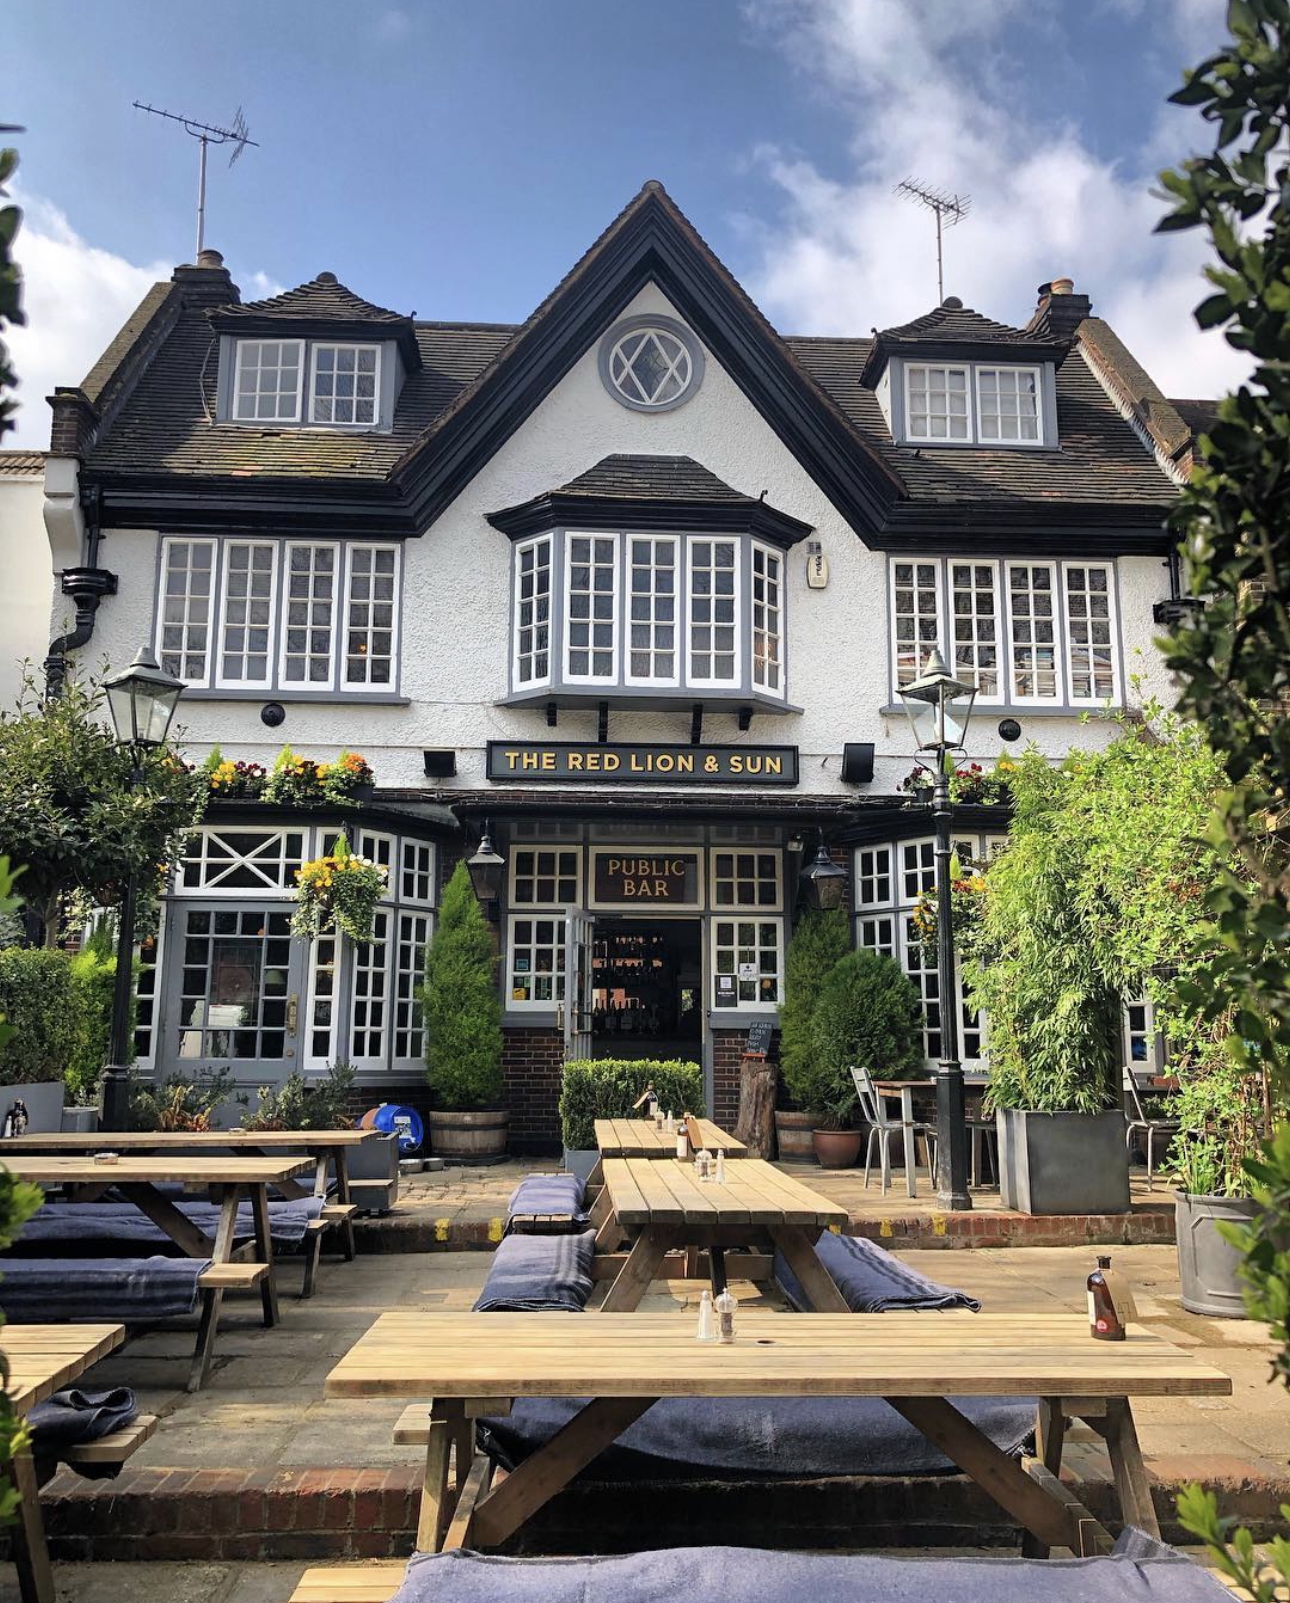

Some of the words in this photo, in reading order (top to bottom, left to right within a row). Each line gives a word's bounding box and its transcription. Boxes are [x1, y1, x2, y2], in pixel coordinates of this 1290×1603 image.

[505, 752, 556, 770] THE
[568, 753, 621, 771] RED
[631, 754, 694, 773] LION
[703, 755, 719, 773] &
[729, 756, 782, 774] SUN
[608, 859, 685, 876] PUBLIC
[623, 880, 669, 897] BAR
